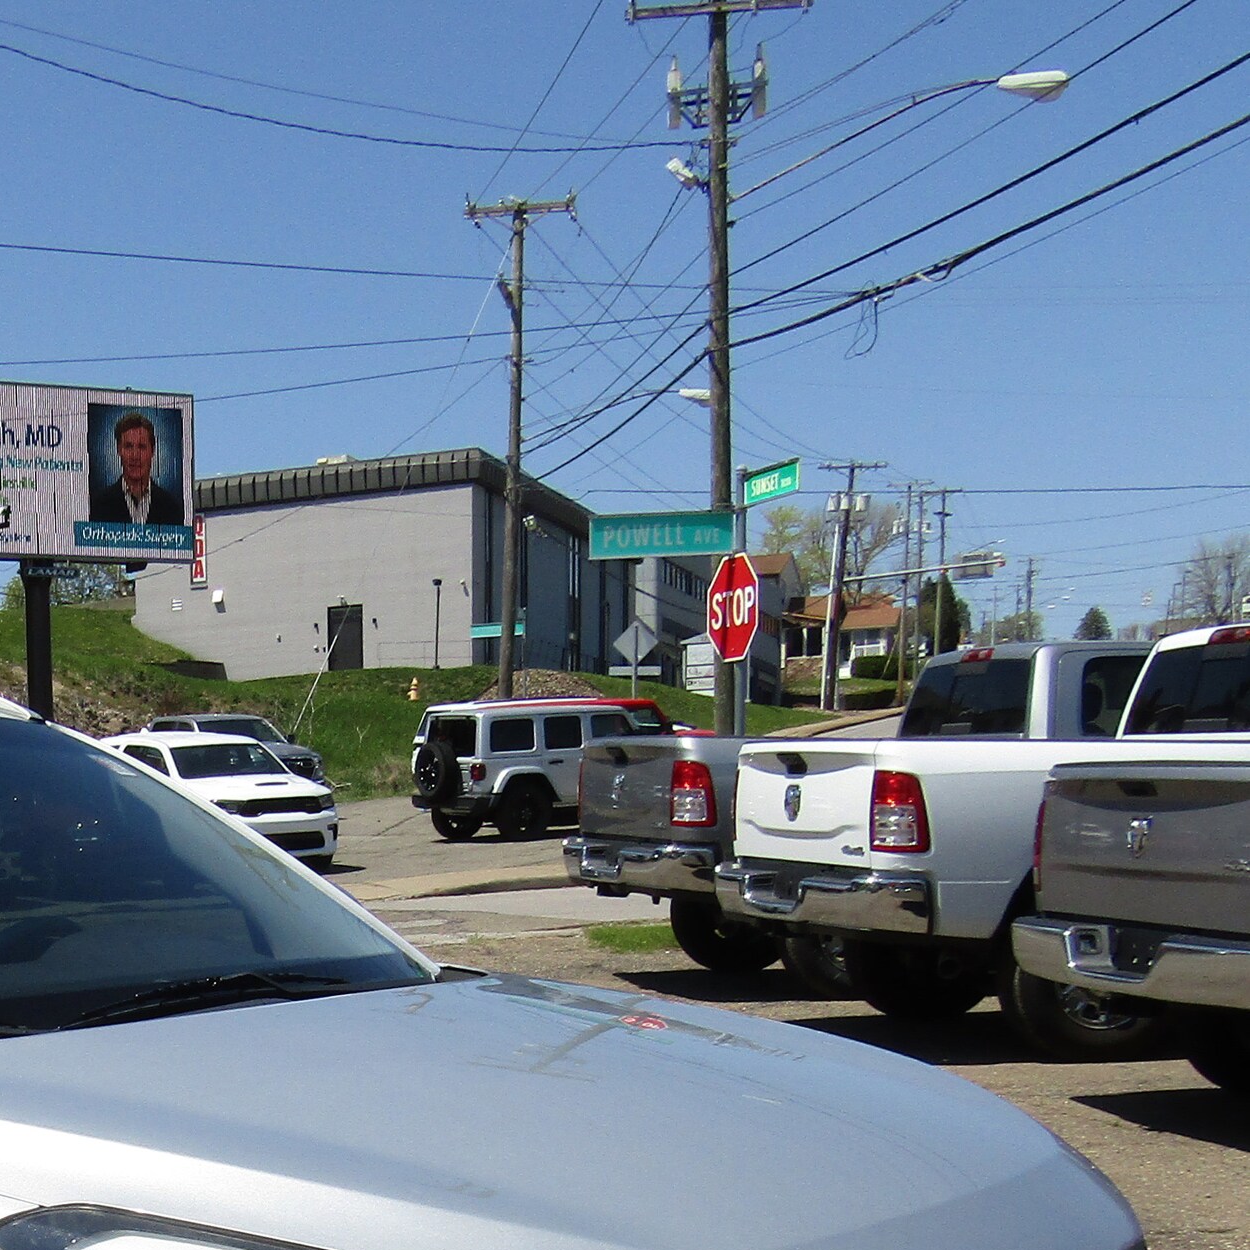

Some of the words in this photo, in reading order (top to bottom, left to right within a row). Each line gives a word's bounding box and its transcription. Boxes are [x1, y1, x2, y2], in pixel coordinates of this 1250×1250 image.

[25, 424, 63, 448] MD
[5, 453, 32, 467] New
[751, 472, 780, 497] SUNSET
[82, 526, 143, 544] Orthopedic
[145, 529, 187, 546] Surgery
[603, 521, 685, 549] POWELL
[694, 527, 720, 544] AVE
[27, 567, 75, 577] LAMAR
[711, 586, 755, 631] STOP
